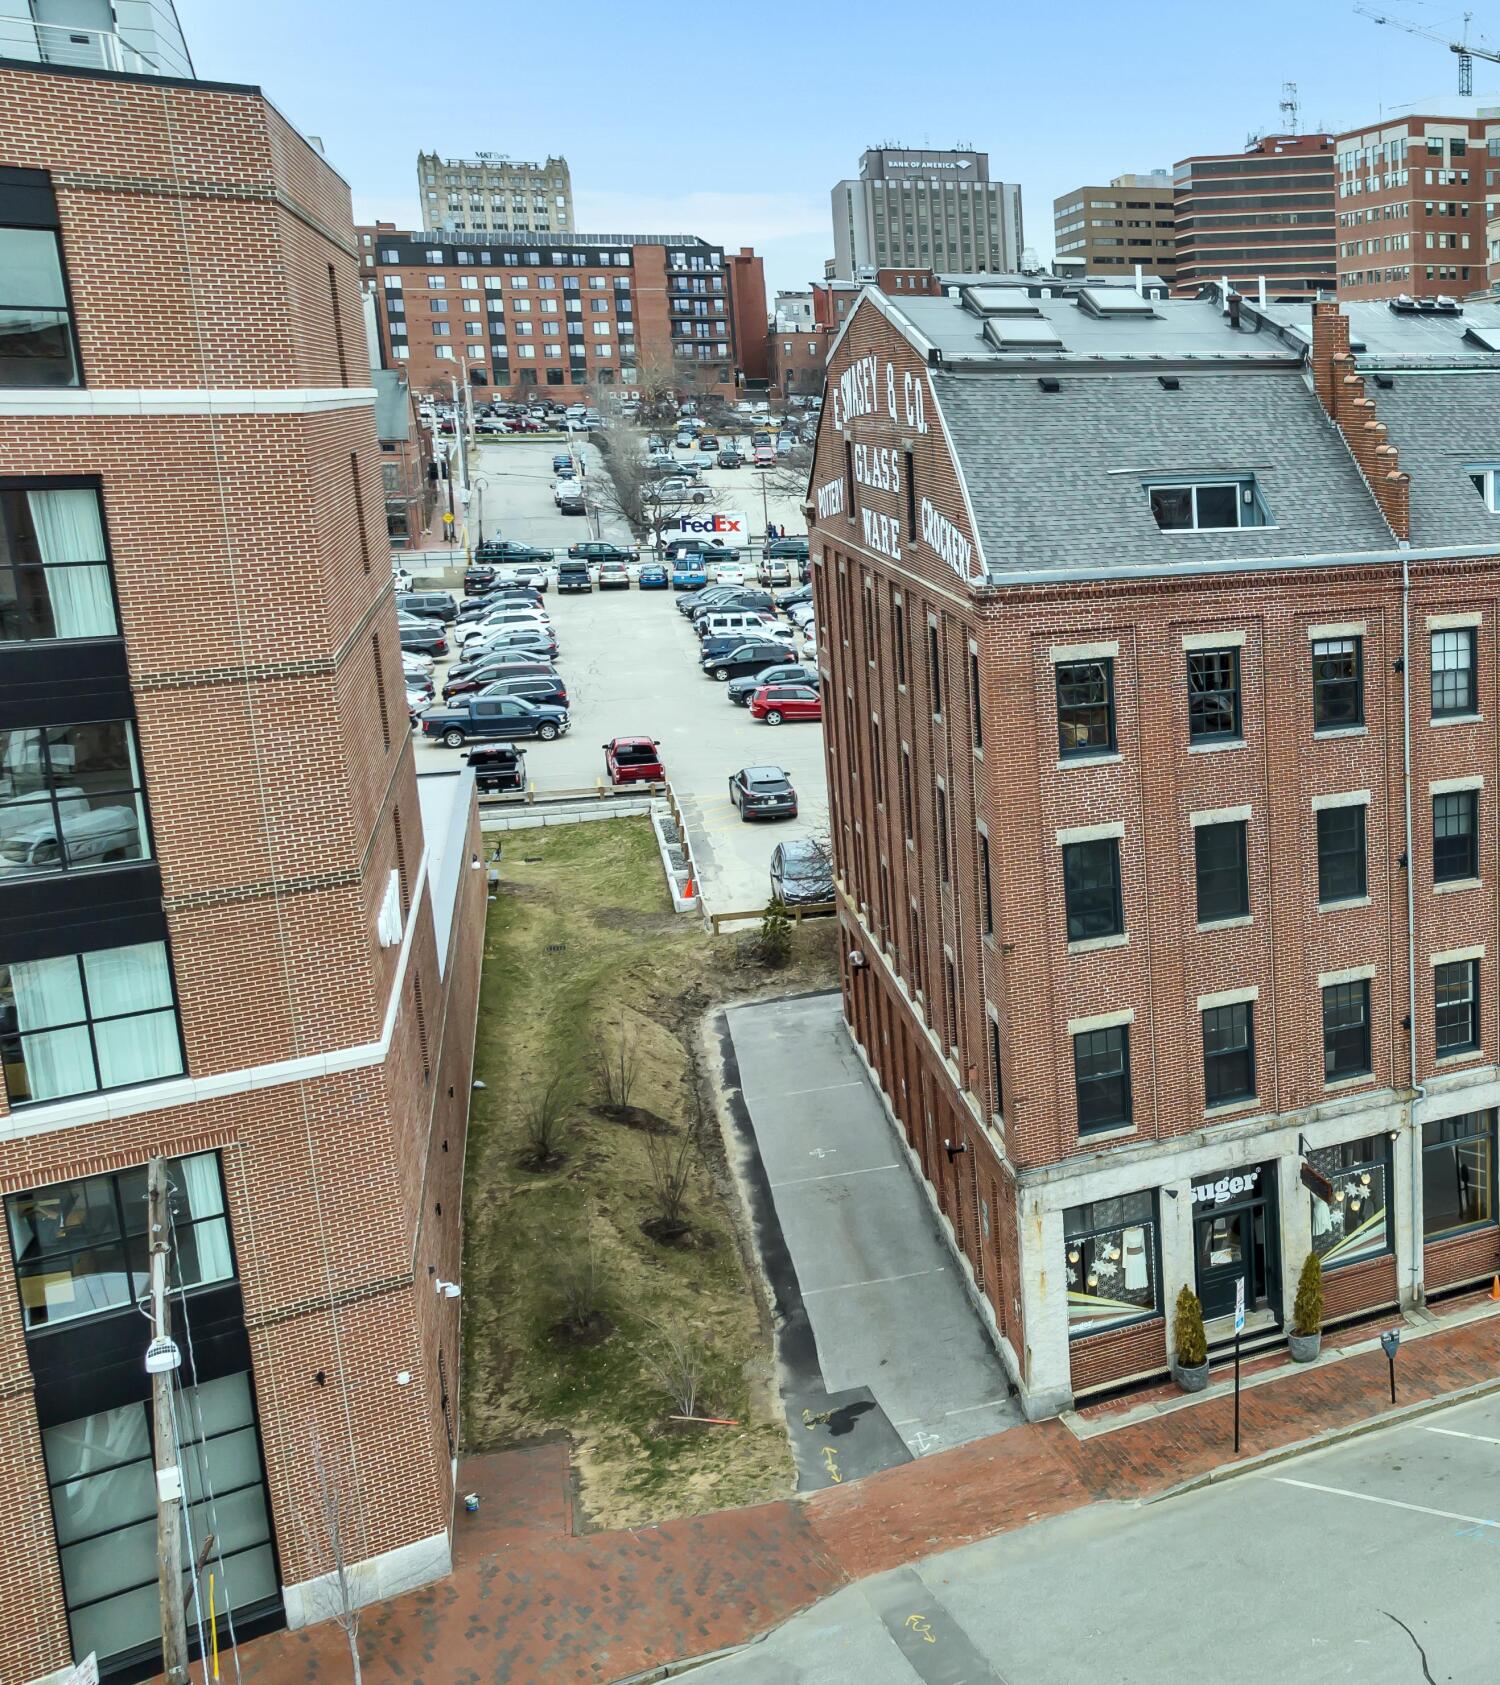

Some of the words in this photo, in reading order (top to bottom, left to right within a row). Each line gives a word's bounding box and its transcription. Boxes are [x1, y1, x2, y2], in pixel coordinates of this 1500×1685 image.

[910, 161, 921, 169] OF
[921, 161, 956, 169] AMERICA
[841, 355, 878, 424] SWASEY
[886, 362, 898, 425] &
[854, 443, 900, 493] GLASS
[681, 514, 741, 532] FedEx
[817, 476, 844, 520] POTTERY
[861, 507, 902, 561] WARE
[921, 496, 972, 583] CROCKERY
